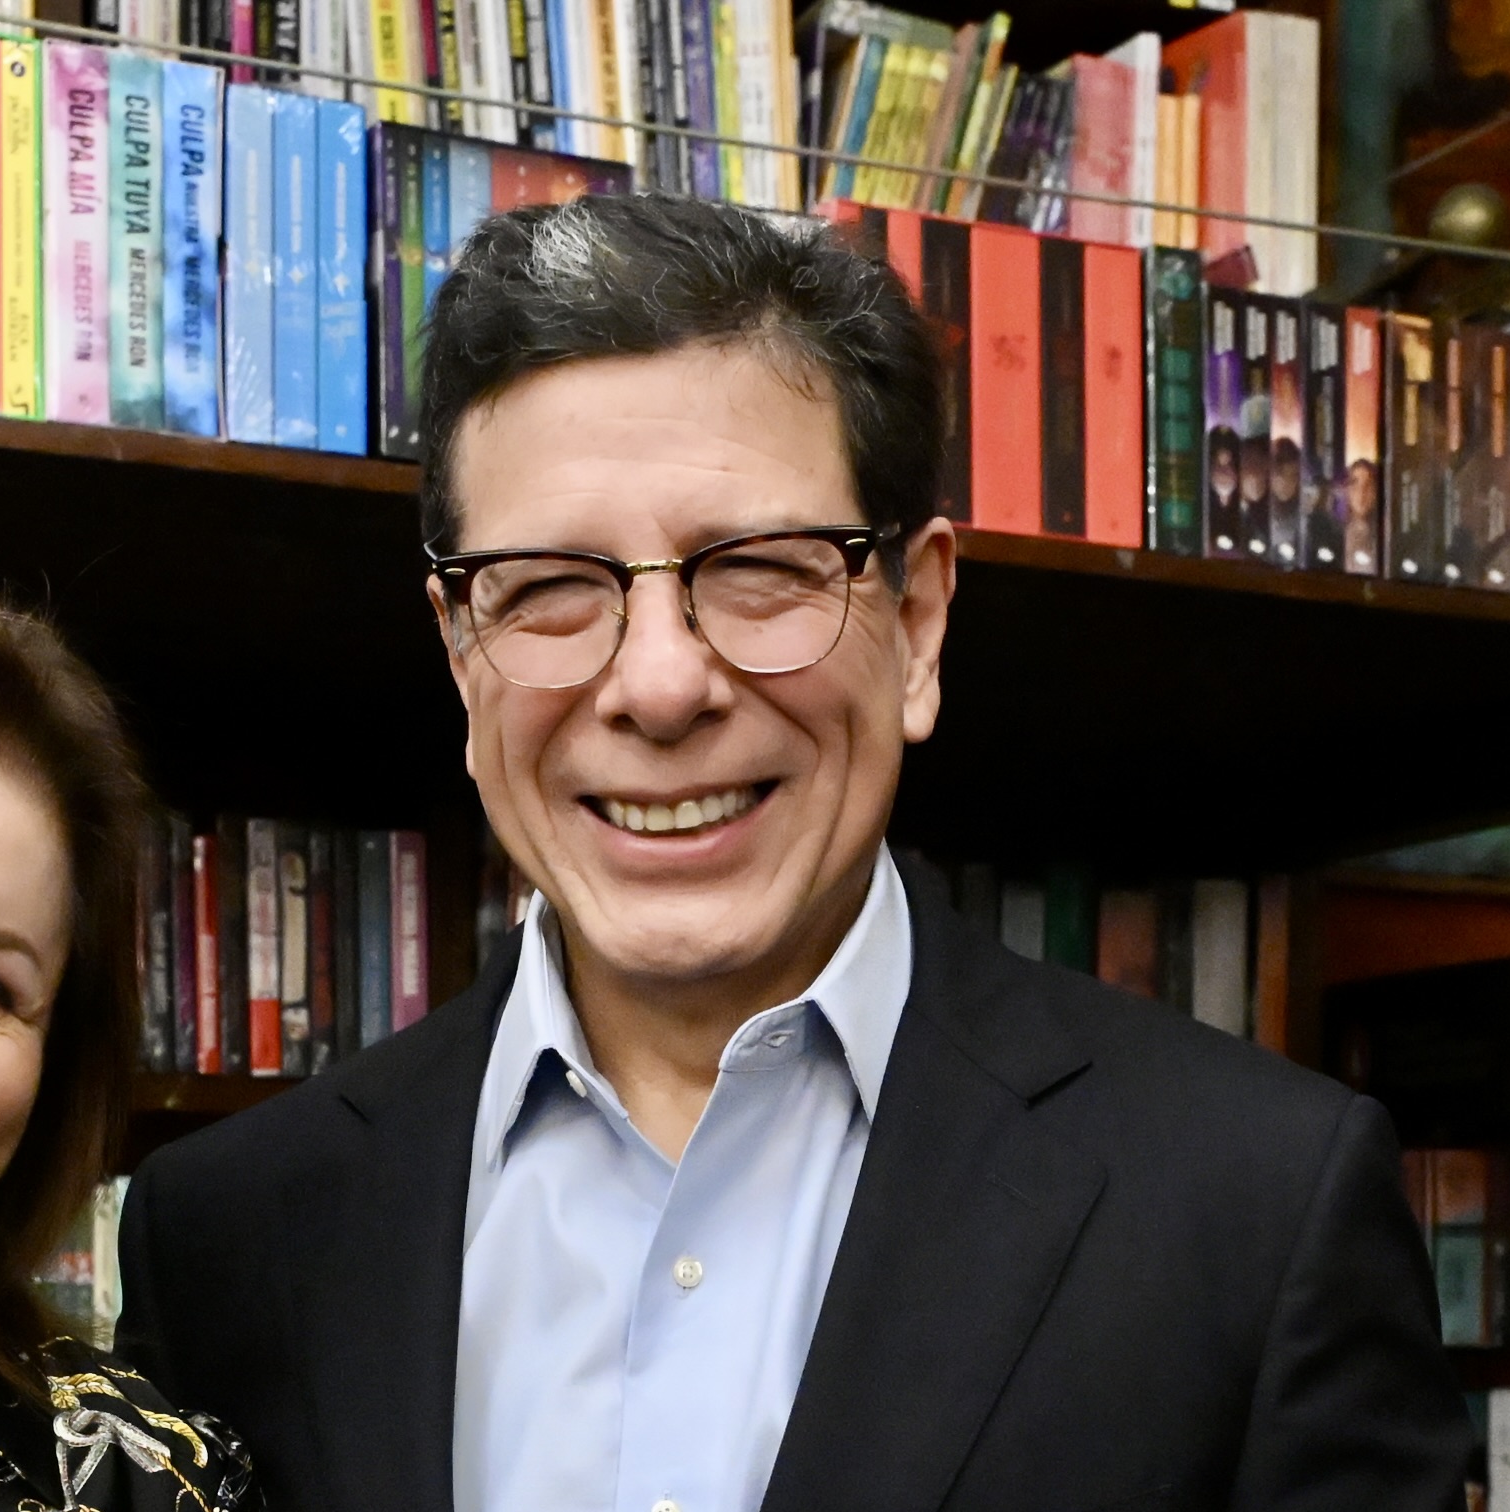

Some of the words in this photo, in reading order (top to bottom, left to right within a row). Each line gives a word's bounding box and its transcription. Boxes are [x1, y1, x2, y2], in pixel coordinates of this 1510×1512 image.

[68, 88, 97, 164] CULPA
[123, 94, 150, 168] CULPA
[180, 104, 205, 178] CULPA
[68, 171, 102, 215] MÍA
[124, 179, 151, 236] TUYA
[73, 239, 91, 324] MERCEDES
[128, 247, 147, 332] MERCEDES
[128, 335, 147, 368] RON
